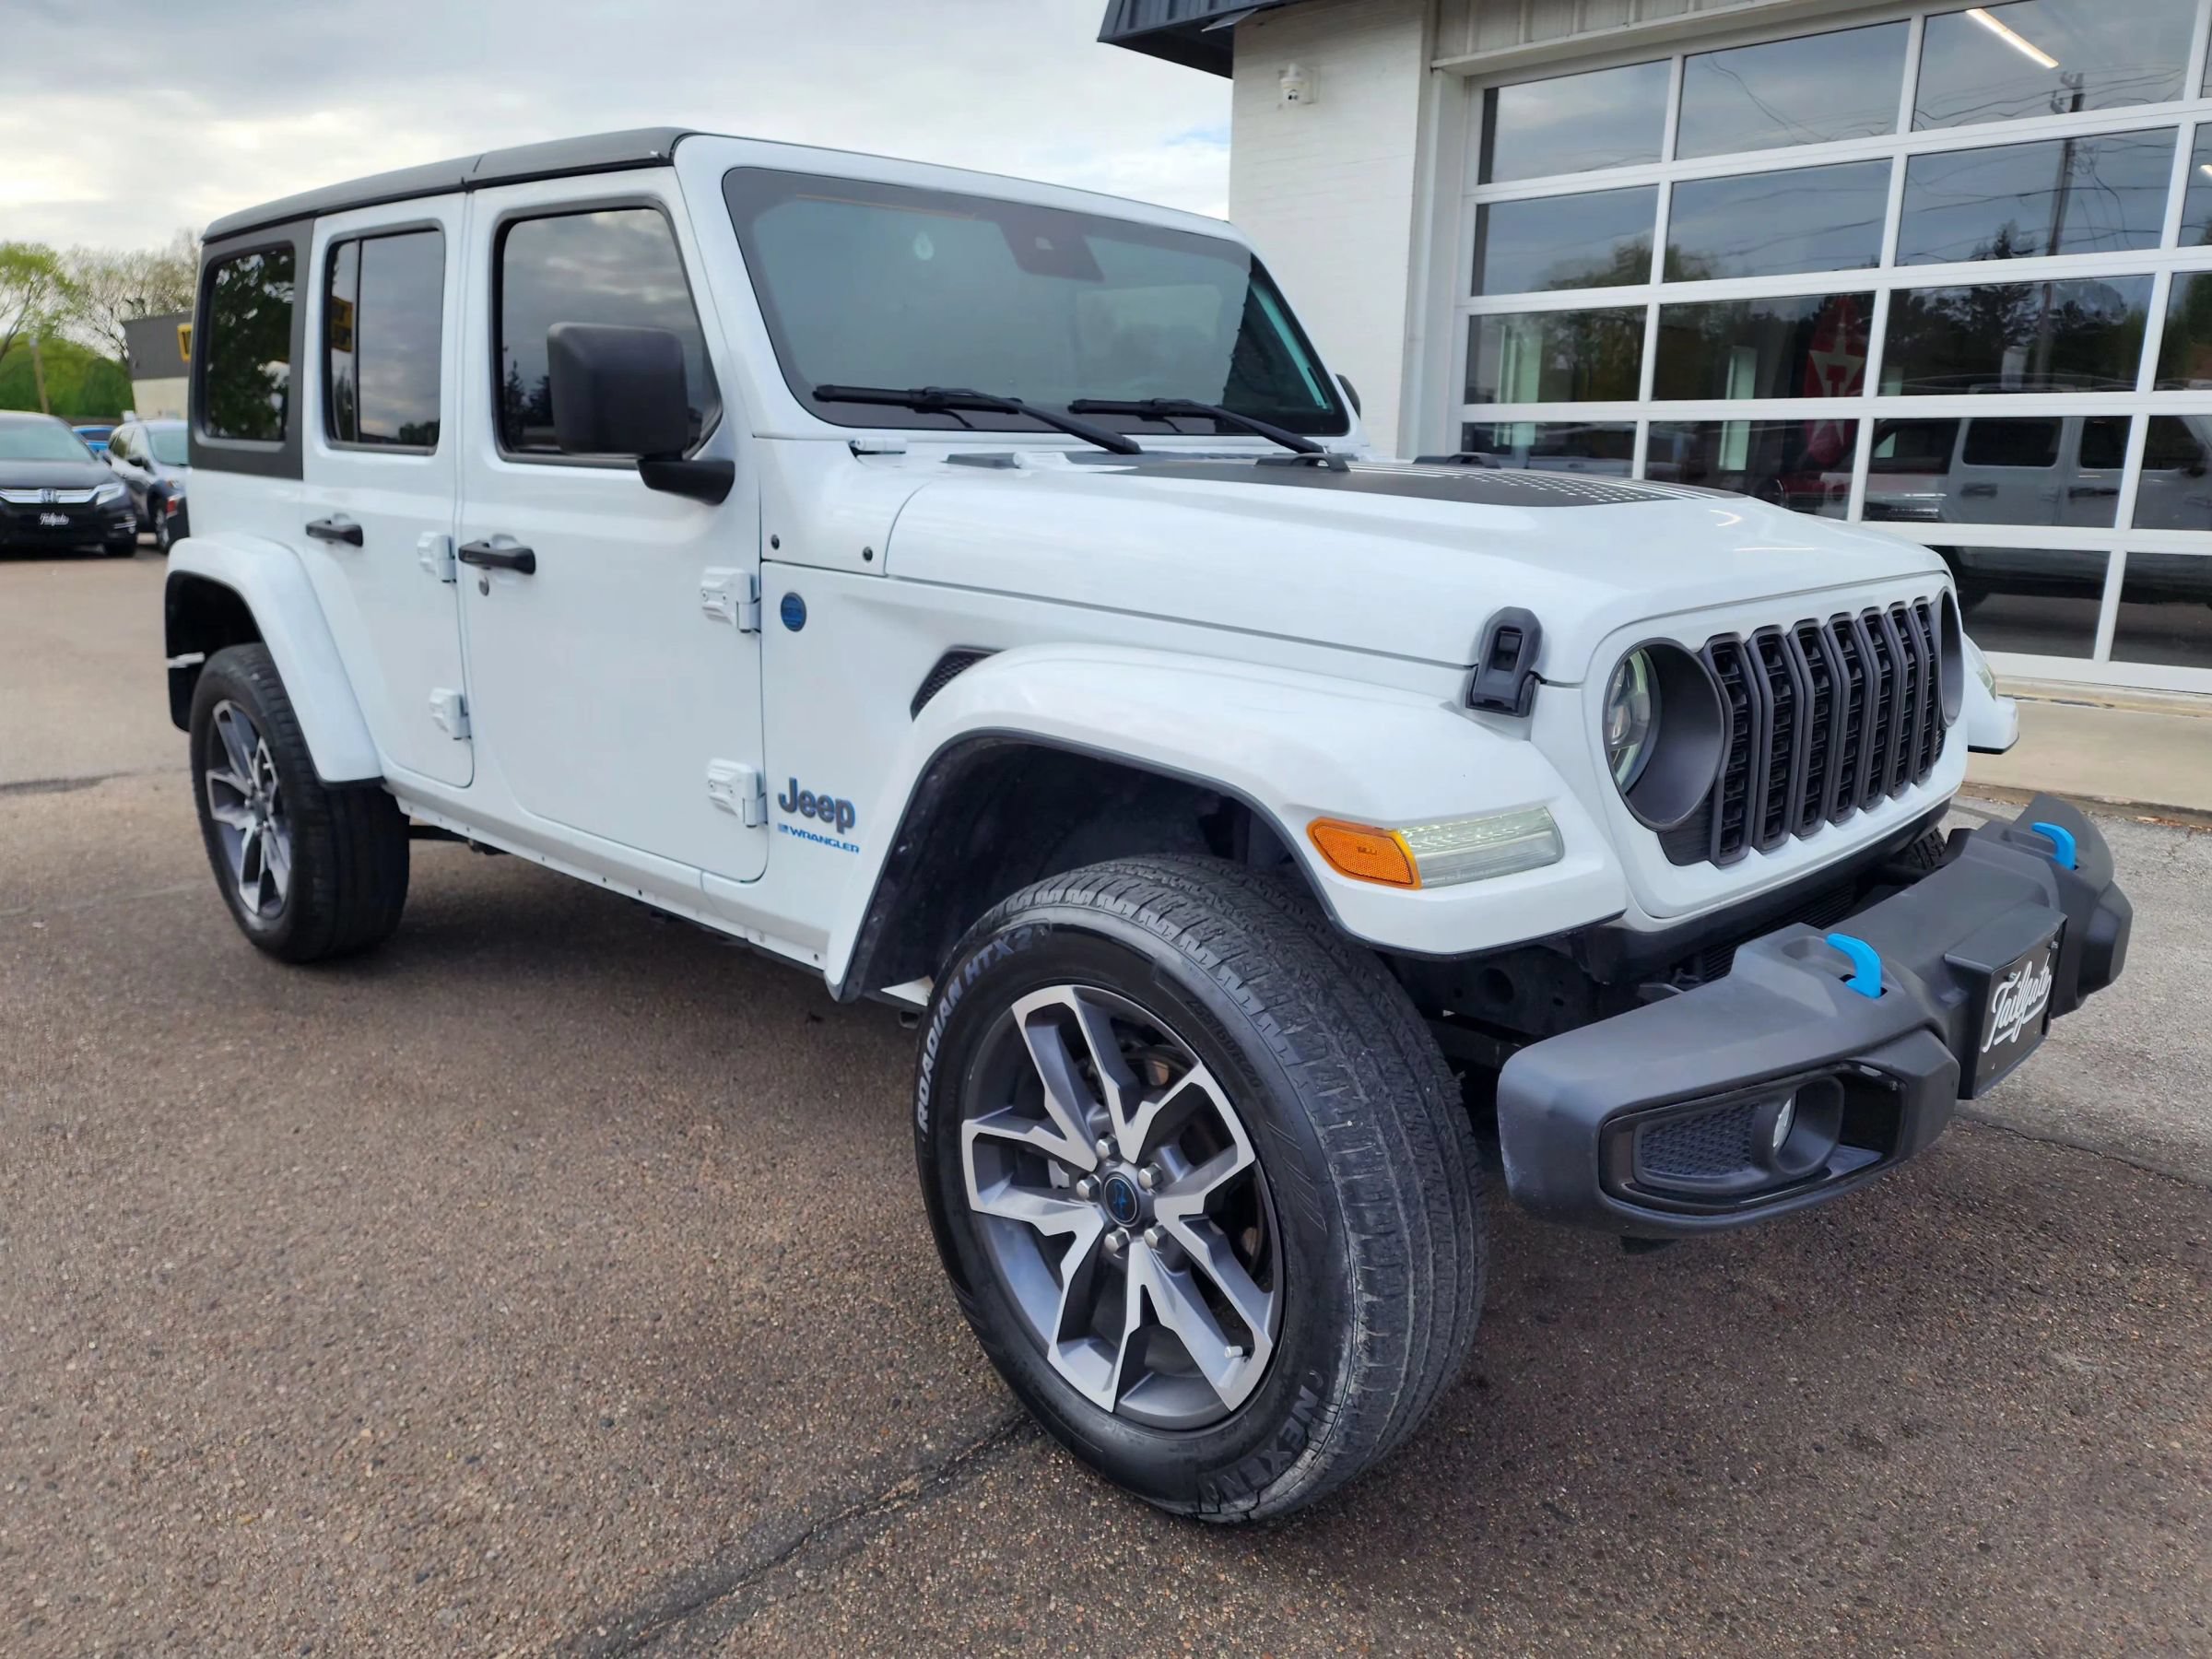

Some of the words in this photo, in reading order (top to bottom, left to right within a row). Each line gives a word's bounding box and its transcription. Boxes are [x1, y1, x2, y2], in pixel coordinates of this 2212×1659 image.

[777, 776, 855, 834] Jeep
[789, 826, 860, 853] WRANGLER
[916, 978, 964, 1135] ROADIAN
[1216, 1384, 1320, 1504] NEXEN
